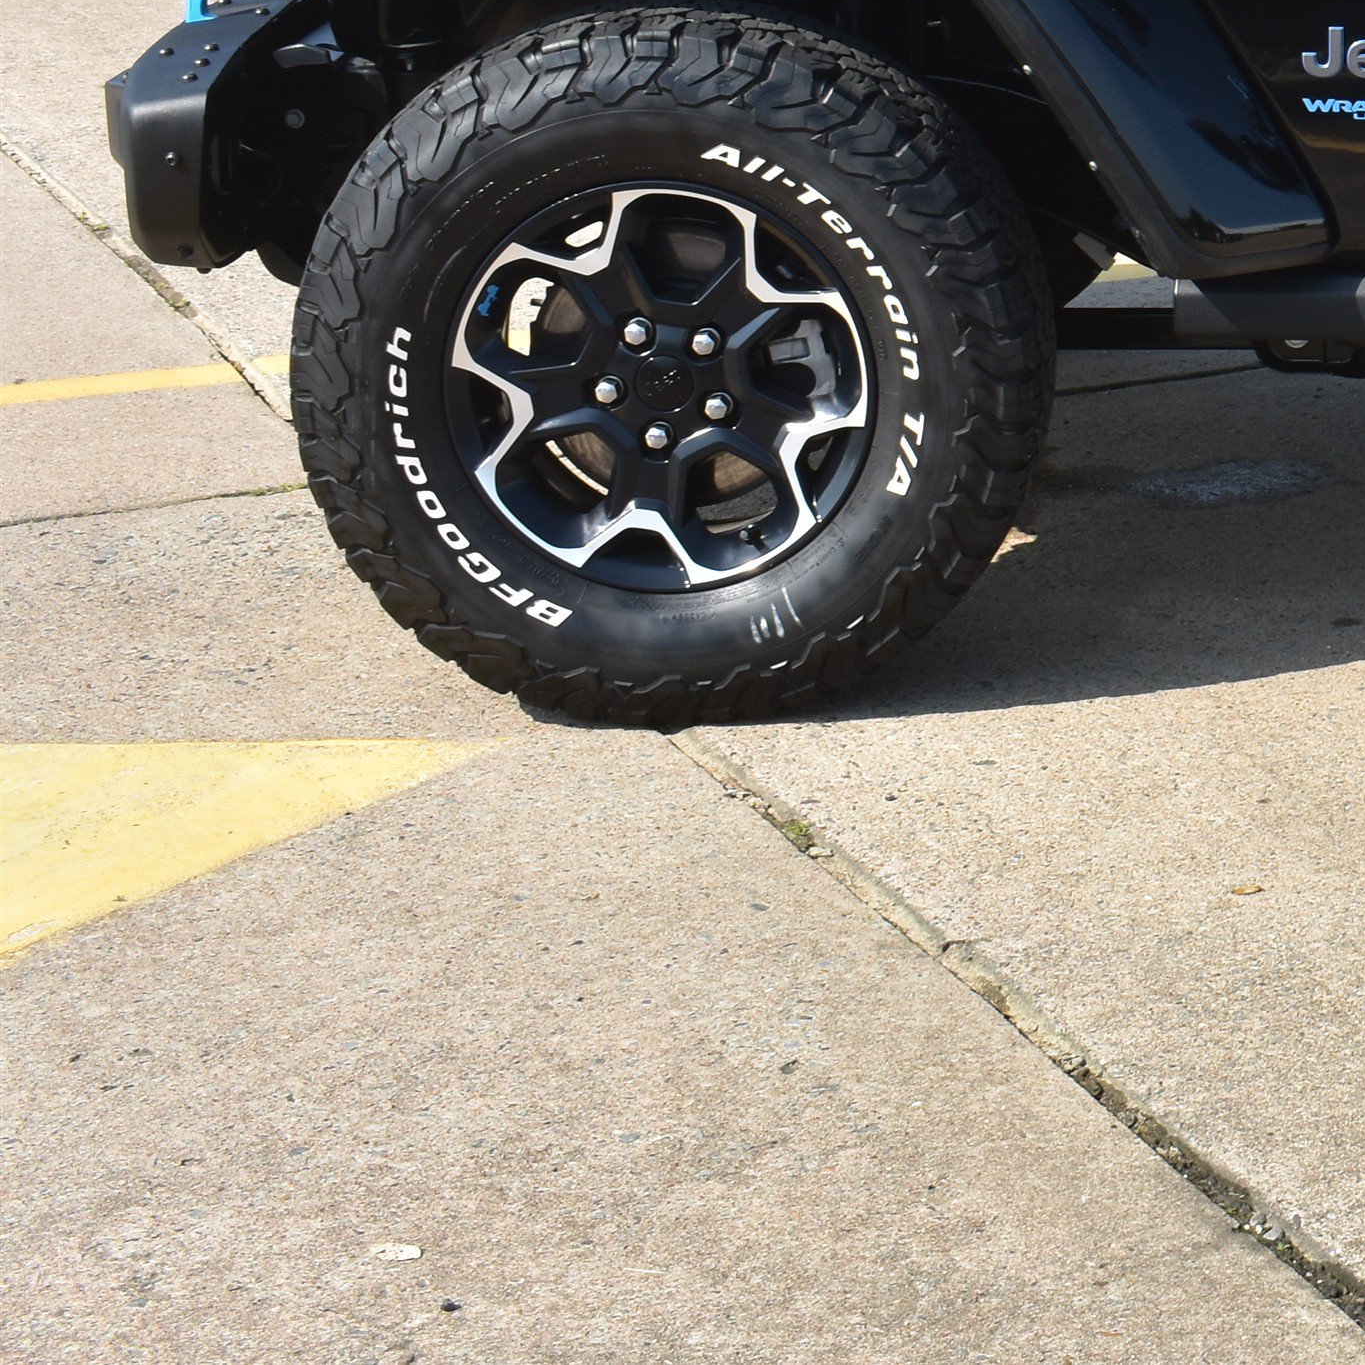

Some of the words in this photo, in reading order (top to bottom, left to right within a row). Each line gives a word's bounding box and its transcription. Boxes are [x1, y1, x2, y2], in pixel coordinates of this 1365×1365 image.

[382, 326, 574, 628] BFGoodrich
[701, 142, 923, 382] All-Terrain
[885, 411, 925, 496] T/A
